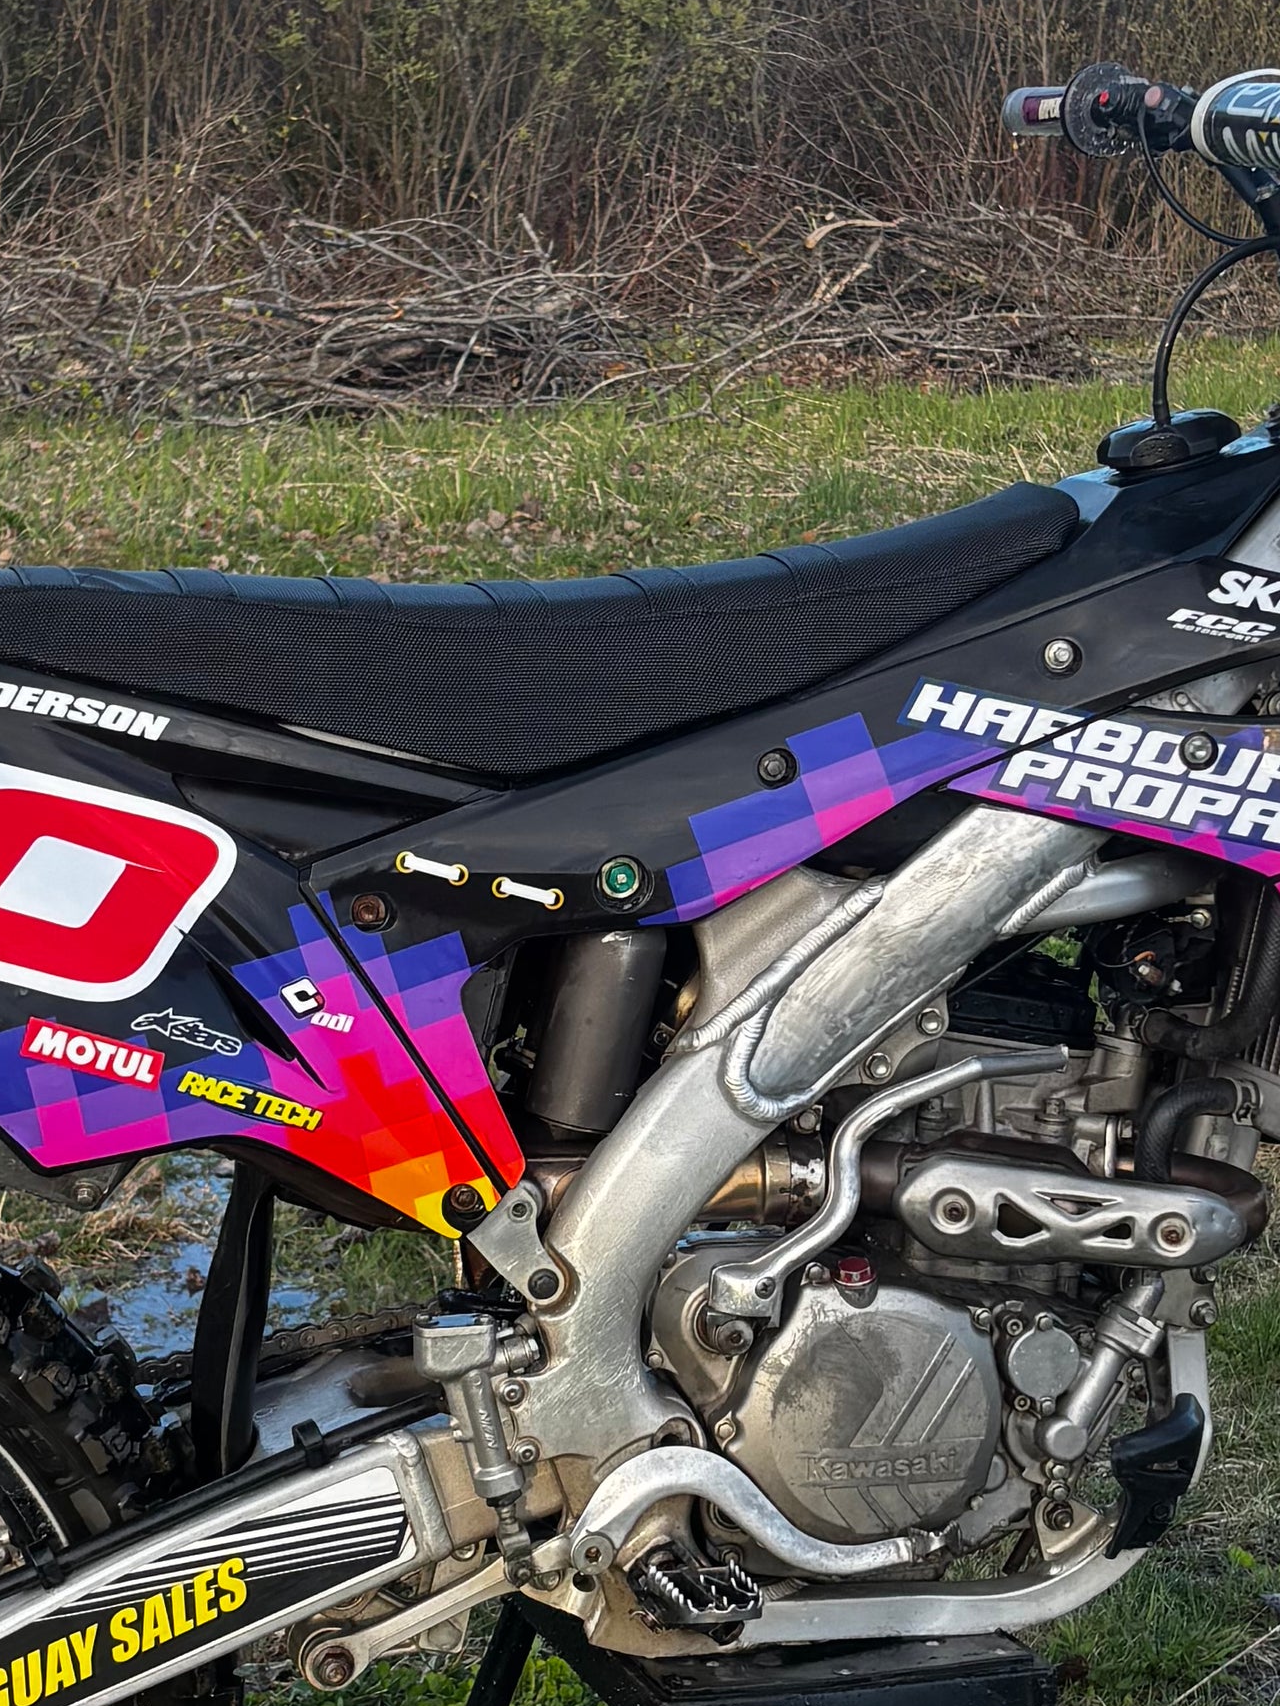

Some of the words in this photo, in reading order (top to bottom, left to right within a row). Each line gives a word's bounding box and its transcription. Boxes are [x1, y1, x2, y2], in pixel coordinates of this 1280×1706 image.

[1167, 608, 1277, 637] FCC
[29, 1027, 156, 1084] MOTUL
[177, 1071, 253, 1110] RACE
[253, 1091, 323, 1131] TECH
[805, 1448, 958, 1481] Kawasaki
[110, 1557, 248, 1663] SALES
